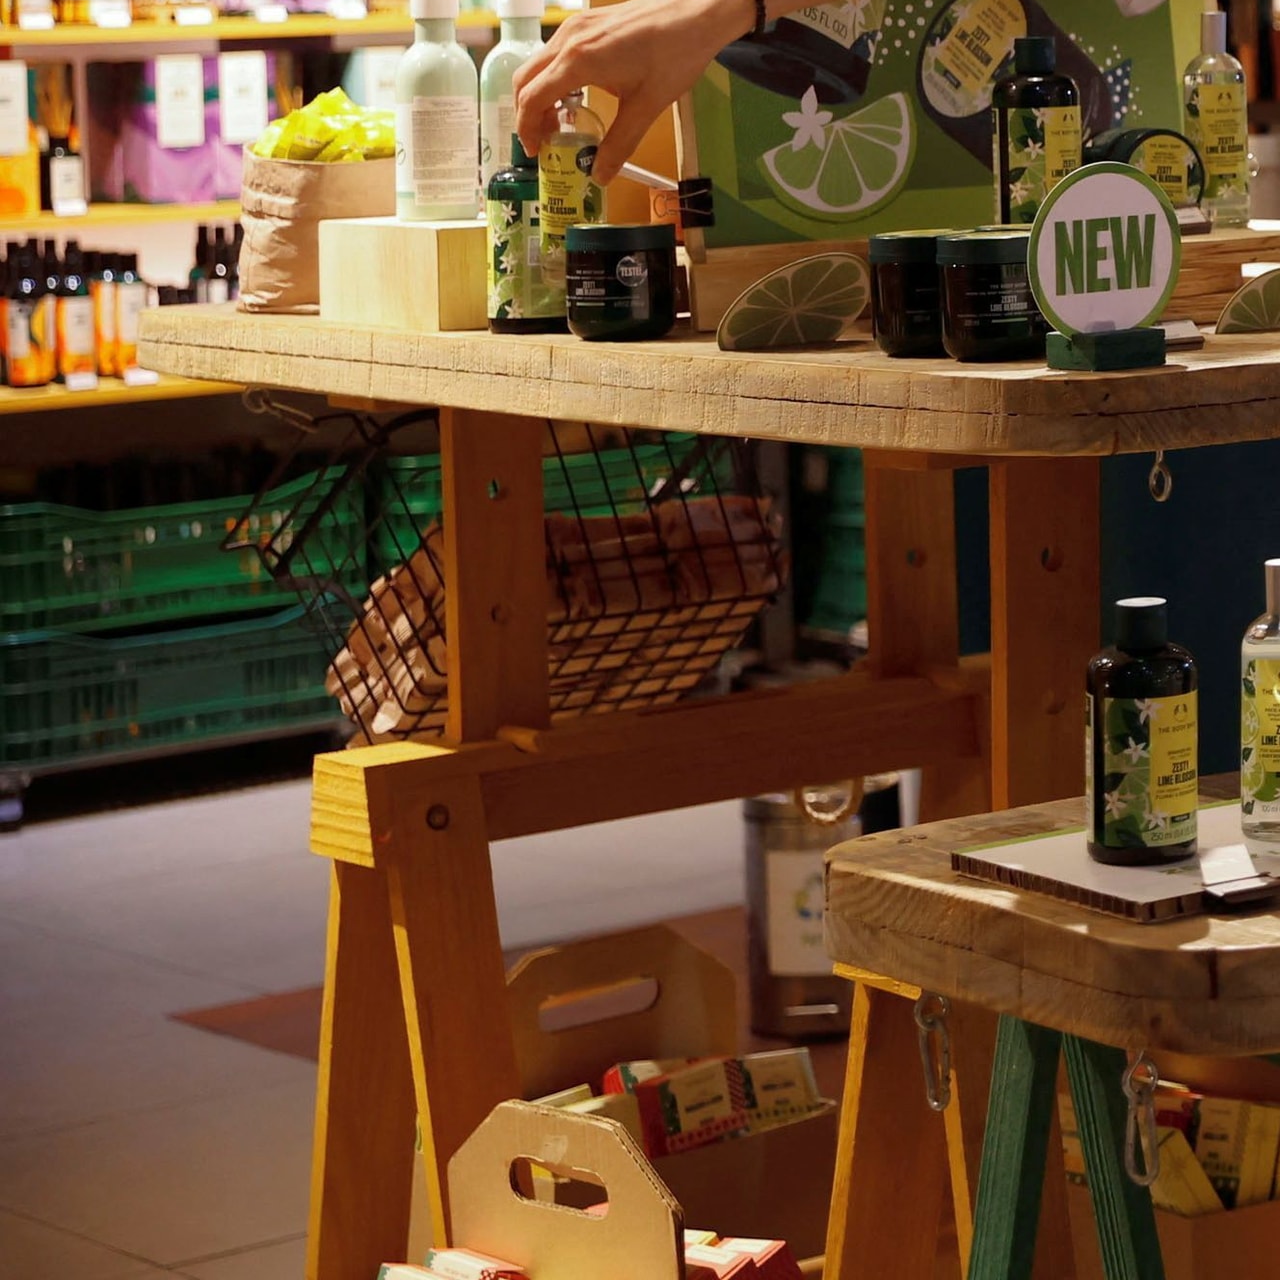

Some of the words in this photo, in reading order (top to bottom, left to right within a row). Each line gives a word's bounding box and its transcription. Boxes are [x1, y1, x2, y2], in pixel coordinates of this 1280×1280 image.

[819, 11, 831, 29] FL
[1054, 213, 1156, 296] NEW
[1002, 295, 1017, 304] ZESTY
[1159, 726, 1170, 734] THE
[1261, 735, 1278, 746] LIME
[1172, 760, 1189, 773] ZESTY
[1157, 775, 1173, 787] LIME
[1151, 831, 1163, 841] 250
[1164, 830, 1172, 838] ml
